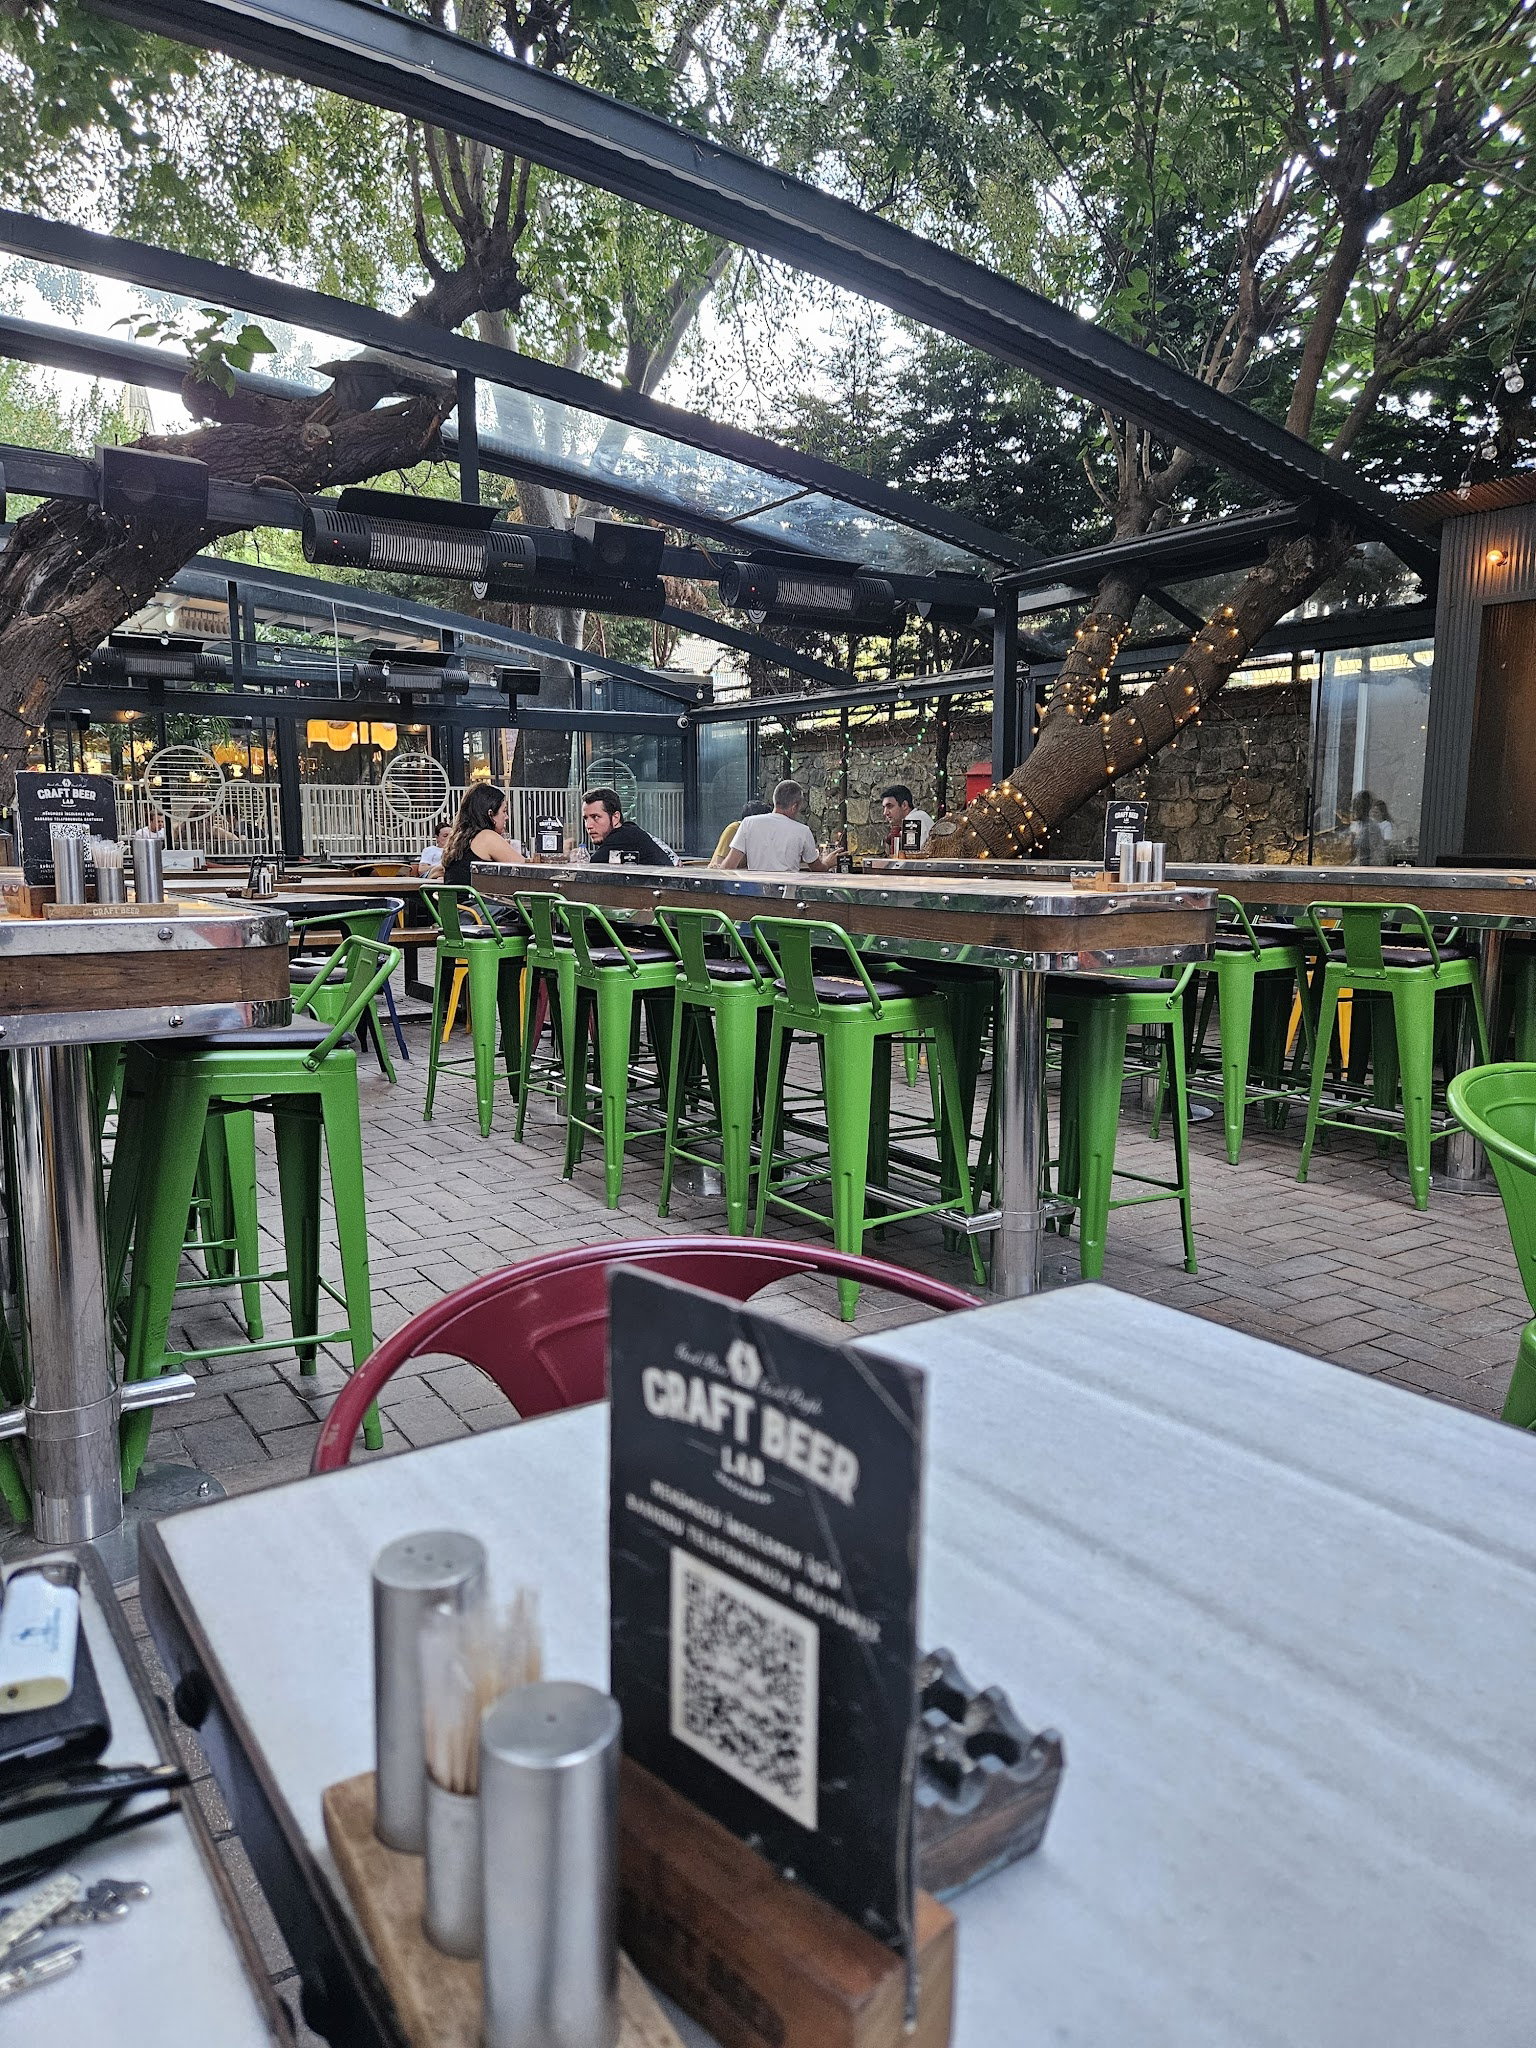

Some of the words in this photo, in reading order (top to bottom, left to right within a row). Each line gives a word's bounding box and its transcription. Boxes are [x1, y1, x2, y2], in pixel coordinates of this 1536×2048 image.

[37, 788, 70, 800] CRAFT
[72, 788, 97, 801] BEER
[92, 907, 118, 916] CRAFT
[120, 906, 140, 915] BEER
[641, 1366, 757, 1445] CRAFT
[759, 1404, 860, 1507] BEER
[719, 1445, 766, 1487] LAB
